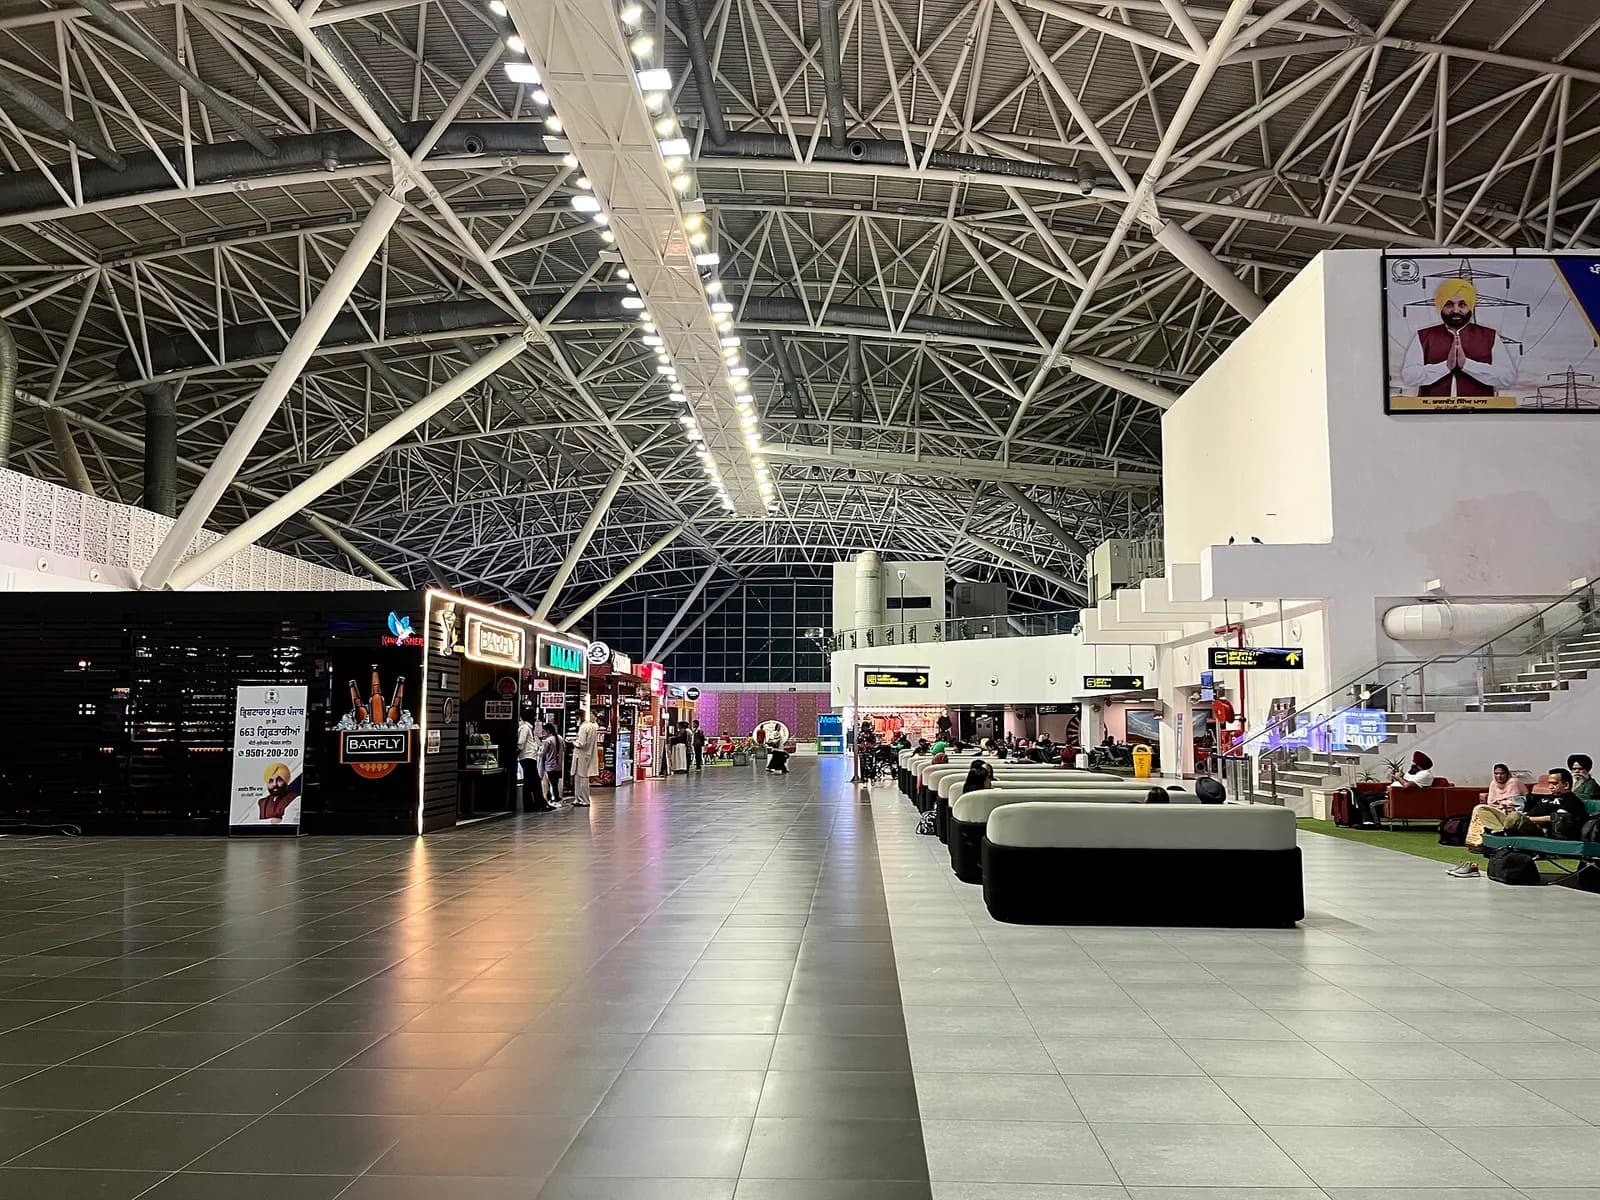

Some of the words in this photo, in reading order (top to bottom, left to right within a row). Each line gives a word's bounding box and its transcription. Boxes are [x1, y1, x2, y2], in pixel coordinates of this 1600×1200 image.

[382, 635, 424, 646] KINISHER
[240, 728, 255, 737] 663
[349, 738, 401, 750] BARFLY
[245, 748, 299, 758] 9501-200-200
